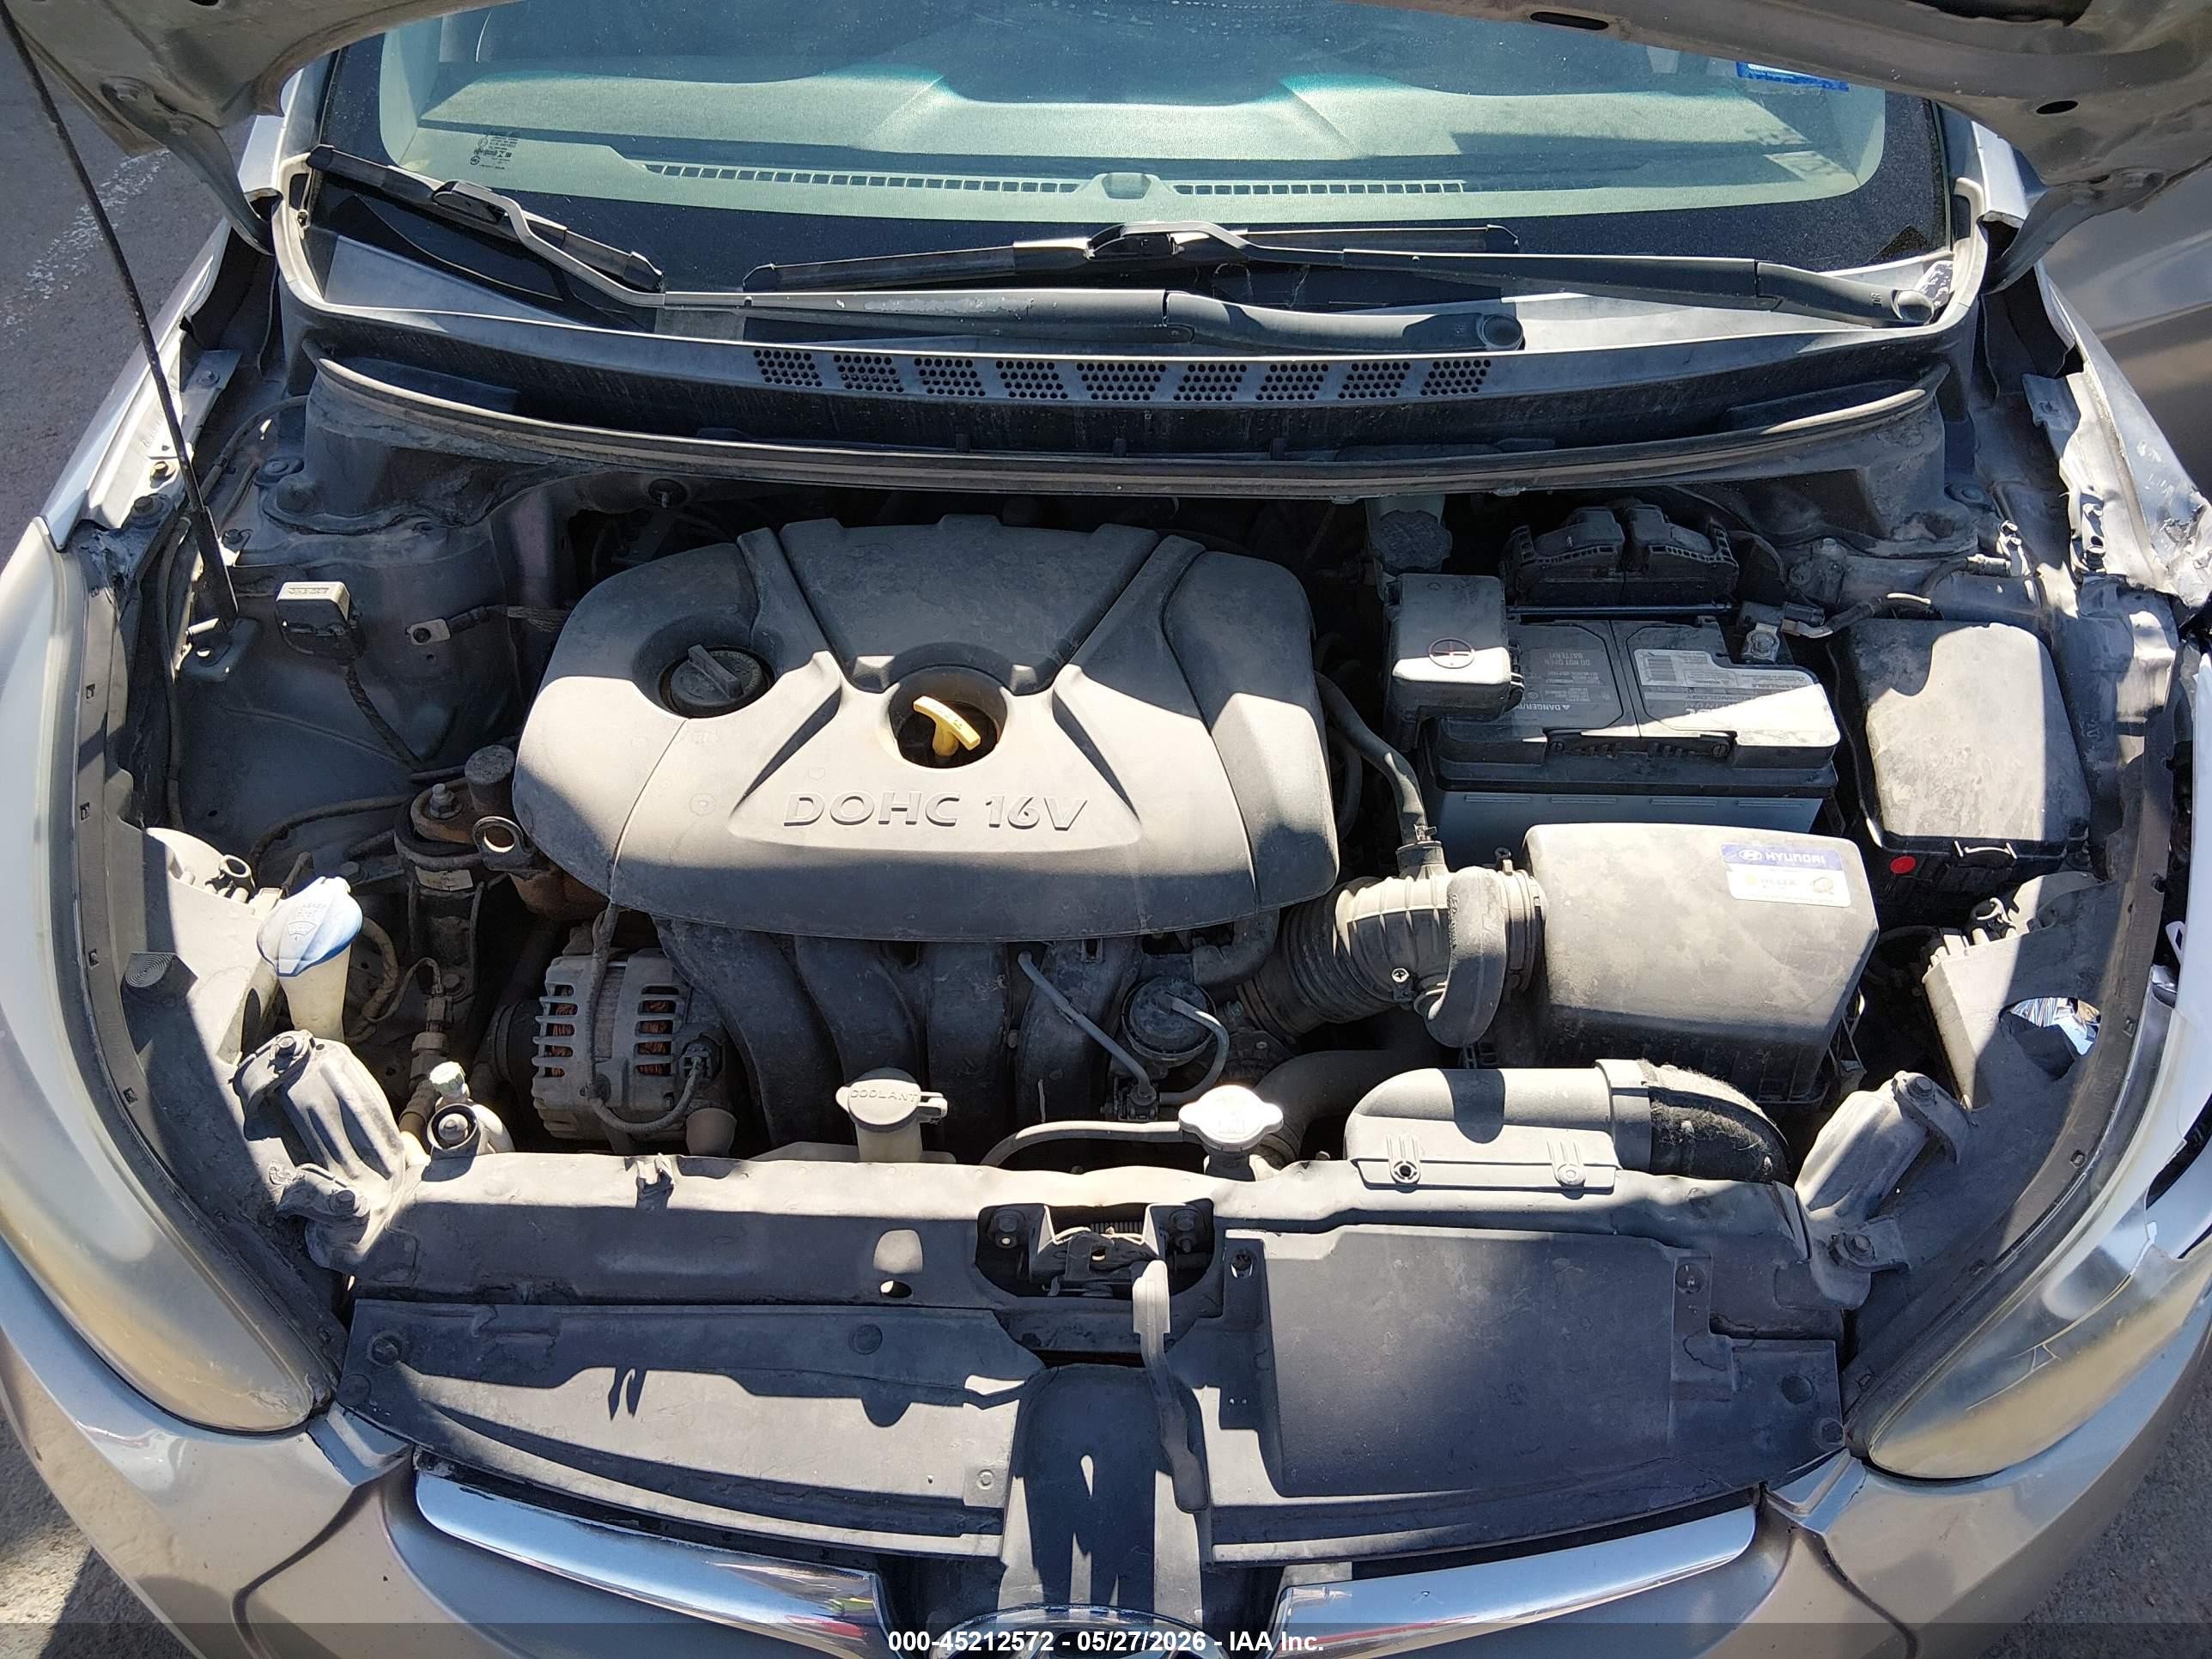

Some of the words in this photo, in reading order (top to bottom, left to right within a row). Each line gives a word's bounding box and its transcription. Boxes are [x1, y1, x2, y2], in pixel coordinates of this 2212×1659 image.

[783, 791, 961, 827] DOHC
[985, 795, 1088, 831] 16V
[1765, 851, 1826, 866] HYUNDAI
[850, 1090, 919, 1103] COOLANT
